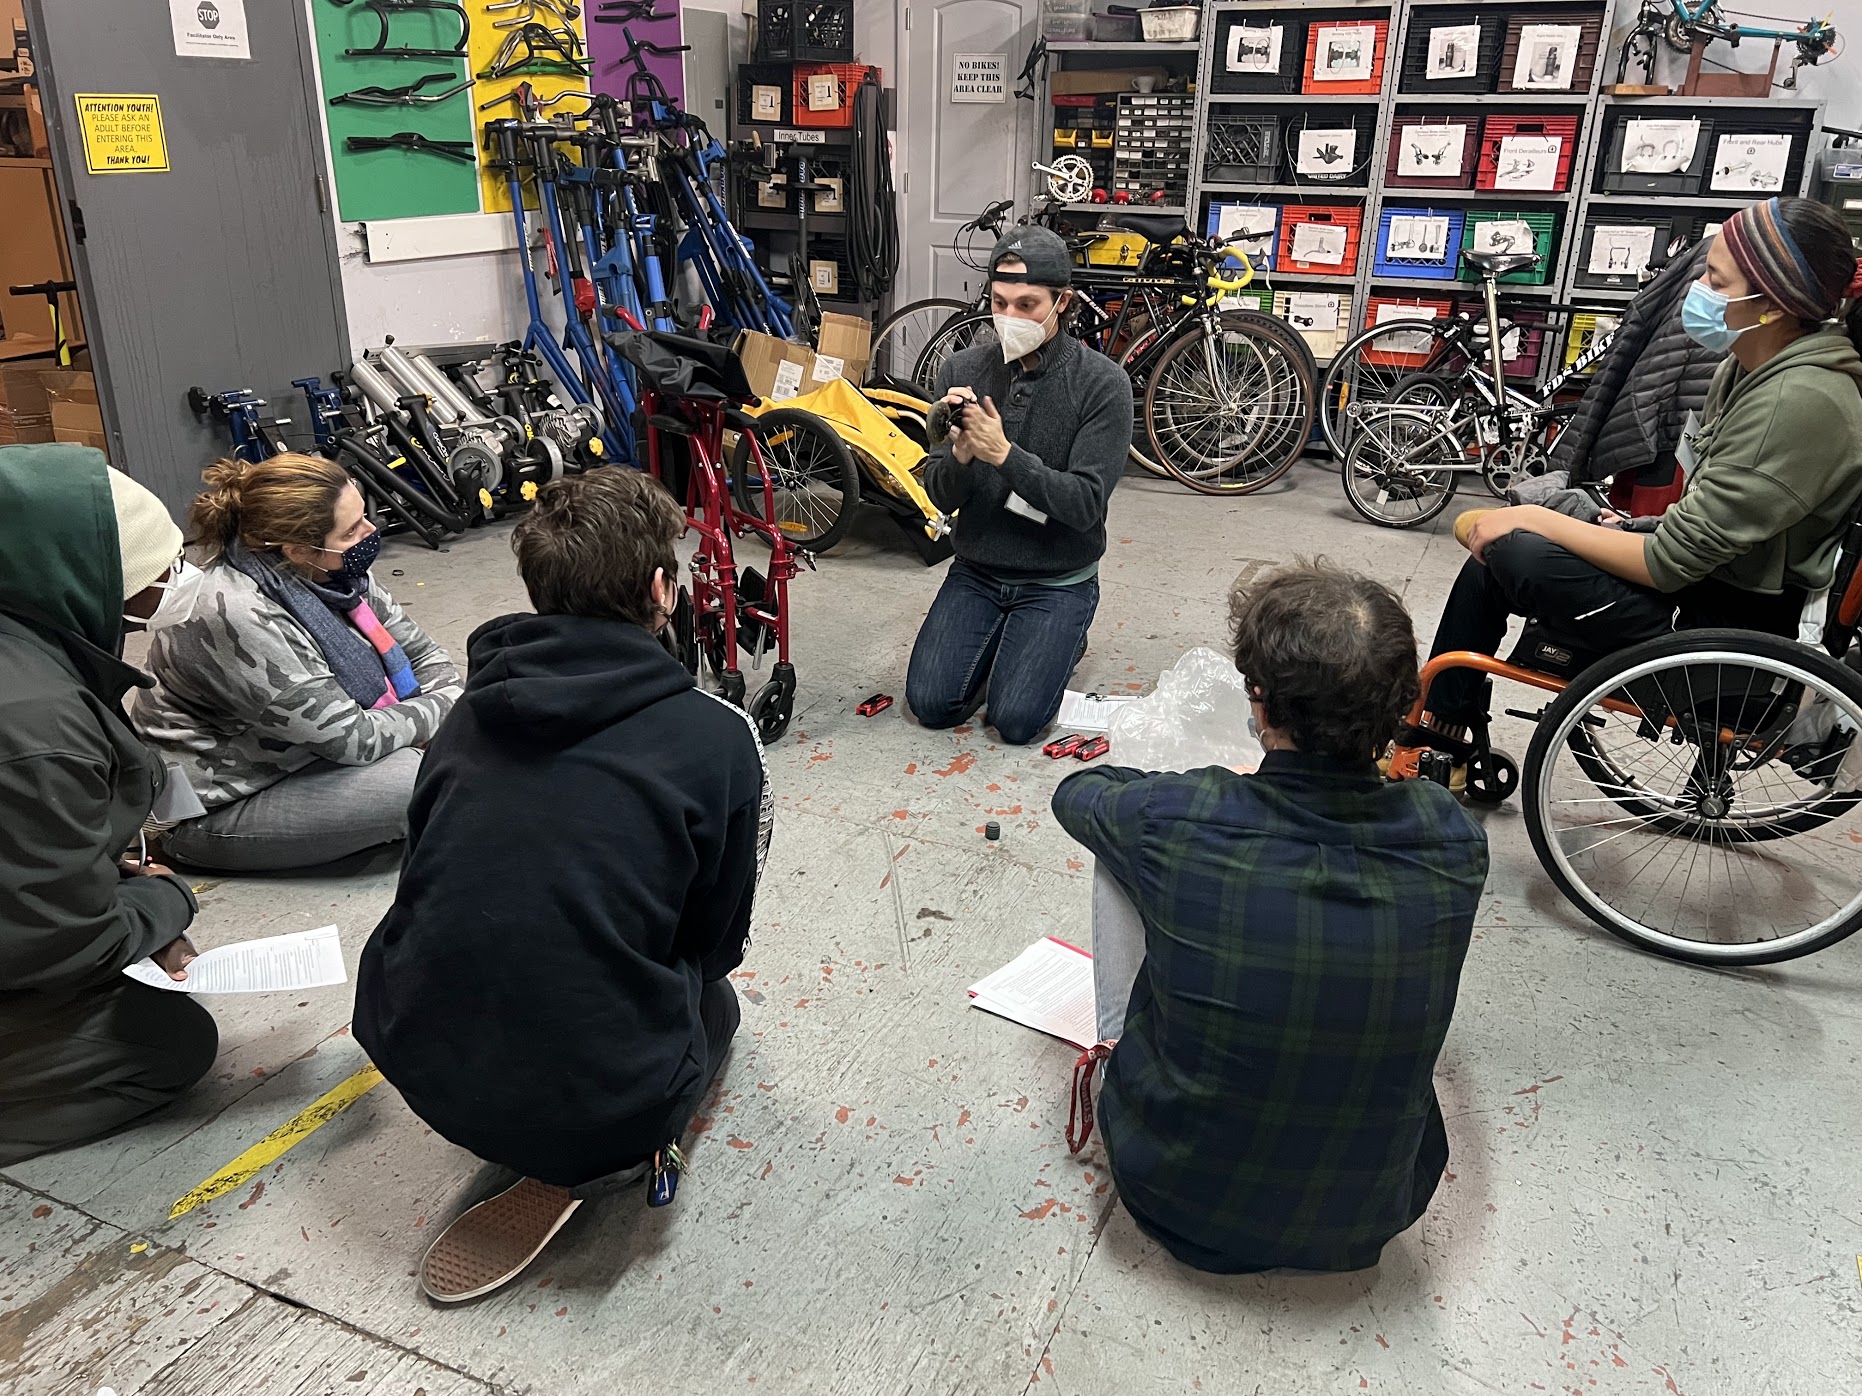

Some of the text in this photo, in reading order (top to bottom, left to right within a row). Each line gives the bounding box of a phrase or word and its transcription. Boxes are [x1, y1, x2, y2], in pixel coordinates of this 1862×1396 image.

[198, 9, 218, 21] STOP
[959, 61, 1000, 70] NO BIKES!
[957, 73, 1001, 82] KEEP THIS
[954, 85, 1002, 94] AREA CLEAR
[85, 103, 153, 112] ATTENTION YOUTH!
[92, 113, 150, 122] PLEASE ASK AN
[95, 124, 151, 132] ADULT BEFORE
[97, 135, 153, 143] ENTERING THIS
[779, 131, 819, 141] Inner Tubes
[1723, 138, 1738, 146] Front
[115, 145, 138, 153] AREA.
[107, 155, 150, 165] THANK YOU!
[1541, 645, 1557, 655] JAY
